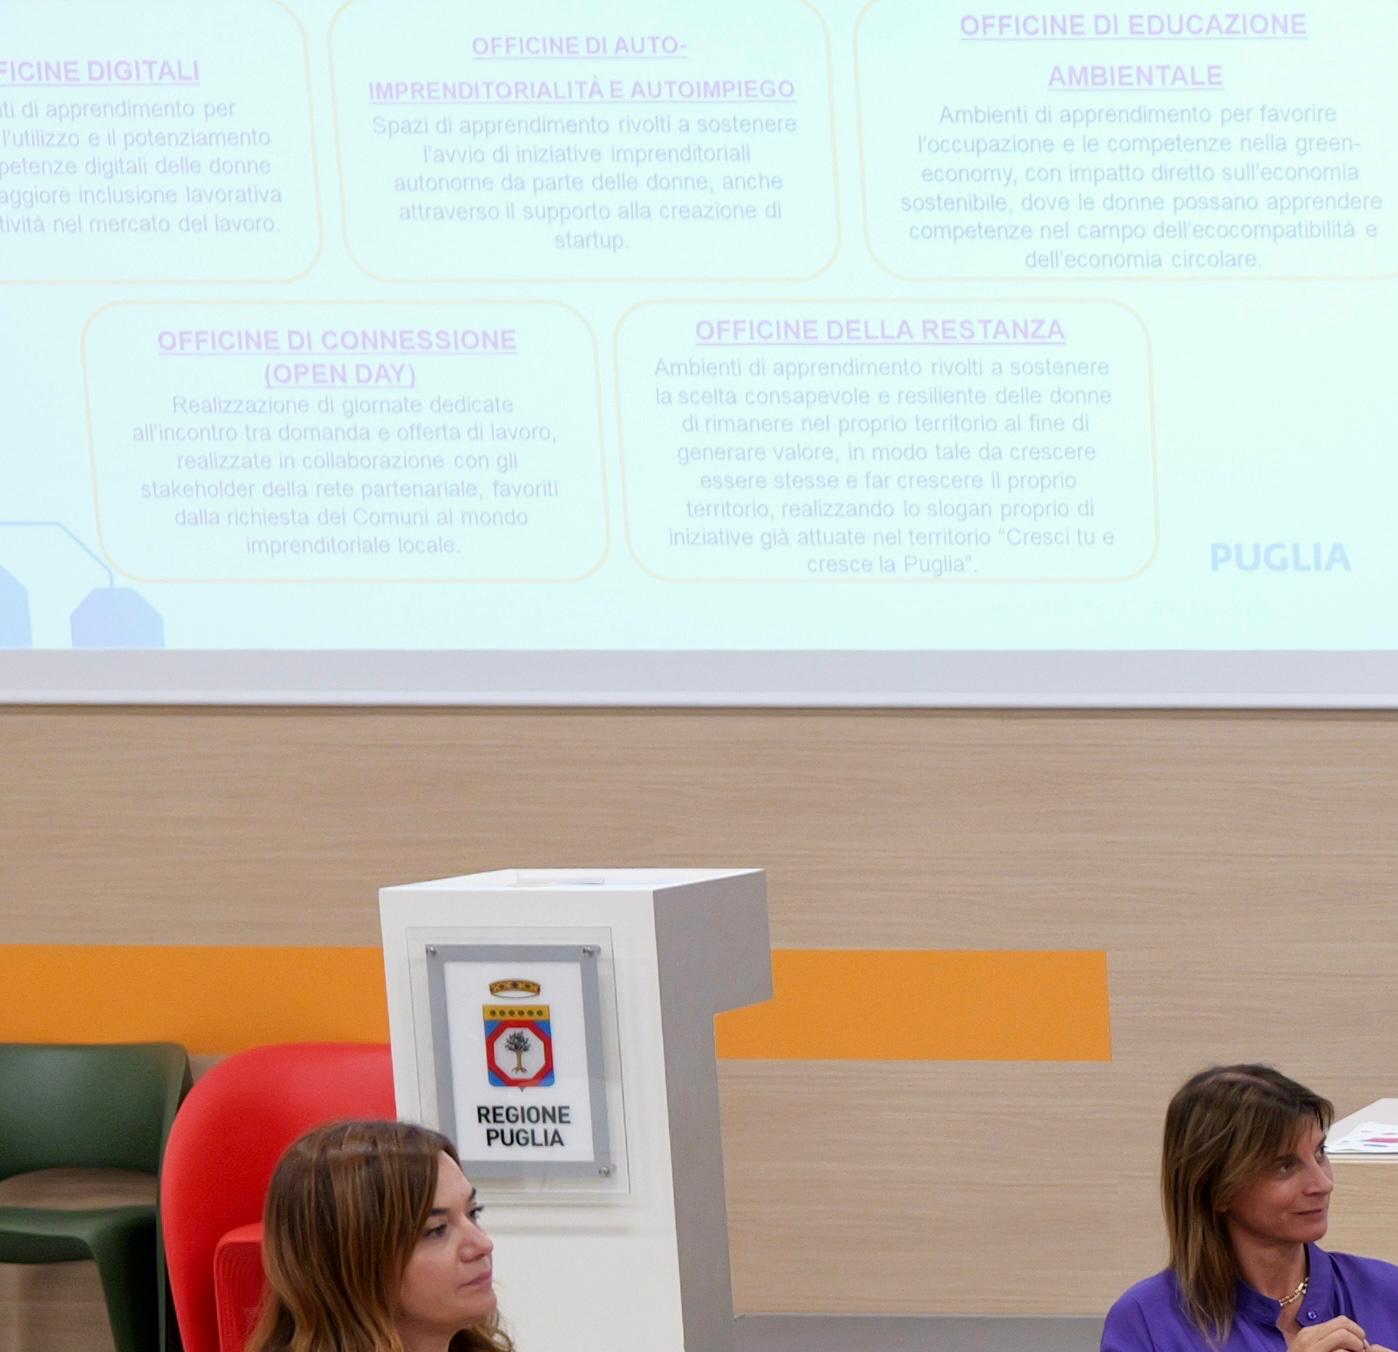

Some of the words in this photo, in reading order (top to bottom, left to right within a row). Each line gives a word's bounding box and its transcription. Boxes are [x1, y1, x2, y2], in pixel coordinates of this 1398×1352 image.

[959, 13, 1086, 37] OFFICINE
[1093, 13, 1119, 36] DI
[1128, 12, 1308, 37] EDUCAZIONE
[471, 35, 581, 56] OFFICINE
[584, 35, 608, 55] DI
[613, 35, 688, 55] AUTO-
[86, 59, 200, 83] DIGITALI
[1047, 64, 1224, 88] AMBIENTALE
[368, 74, 605, 101] IMPRENDITORIALITÀ
[609, 79, 624, 100] E
[630, 79, 796, 100] AUTOIMPIEGO
[938, 104, 1029, 125] Ambienti
[1034, 105, 1053, 125] di
[1059, 104, 1213, 129] apprendimento
[1220, 107, 1254, 128] per
[1259, 103, 1338, 124] favorire
[1061, 137, 1076, 154] e
[1081, 134, 1100, 154] le
[1106, 133, 1233, 158] competenze
[1239, 133, 1288, 153] nella
[1294, 136, 1361, 158] green-
[920, 167, 1018, 188] economy,
[1024, 166, 1063, 183] con
[1068, 163, 1146, 188] impatto
[1150, 162, 1216, 183] diretto
[900, 193, 1014, 215] sostenibile,
[1020, 192, 1071, 212] dove
[1077, 192, 1096, 212] le
[1101, 192, 1166, 212] donne
[1172, 194, 1260, 216] possano
[1266, 191, 1384, 216] apprendere
[908, 221, 1034, 245] competenze
[1039, 220, 1070, 240] nel
[1077, 223, 1147, 245] campo
[1365, 222, 1378, 239] e
[1170, 249, 1262, 269] circolare.
[157, 329, 281, 352] OFFICINE
[287, 329, 313, 352] DI
[320, 328, 517, 352] CONNESSIONE
[695, 319, 819, 341] OFFICINE
[826, 318, 915, 341] DELLA
[921, 318, 1066, 341] RESTANZA
[263, 362, 348, 385] (OPEN
[354, 362, 417, 386] DAY)
[171, 395, 310, 416] Realizzazione
[316, 394, 335, 415] di
[341, 395, 423, 420] giornate
[429, 394, 514, 415] dedicate
[244, 423, 273, 442] tra
[277, 422, 371, 442] domanda
[377, 426, 391, 442] e
[396, 422, 462, 442] offerta
[466, 422, 484, 442] di
[490, 422, 557, 444] lavoro,
[176, 451, 273, 471] realizzate
[278, 452, 297, 470] in
[301, 450, 445, 471] collaborazione
[453, 454, 491, 470] con
[495, 451, 519, 475] gli
[140, 479, 256, 500] stakeholder
[261, 479, 309, 499] della
[315, 480, 355, 498] rete
[360, 479, 484, 503] partenariale,
[491, 478, 559, 499] favoriti
[174, 507, 221, 527] dalla
[226, 507, 311, 527] richiesta
[316, 507, 347, 527] dei
[352, 506, 430, 527] Comuni
[436, 507, 454, 527] al
[460, 507, 529, 527] mondo
[245, 535, 392, 560] imprenditoriale
[397, 535, 461, 555] locale.
[1210, 542, 1352, 573] PUGLIA
[476, 1105, 571, 1125] REGIONE
[486, 1128, 565, 1148] PUGLIA
